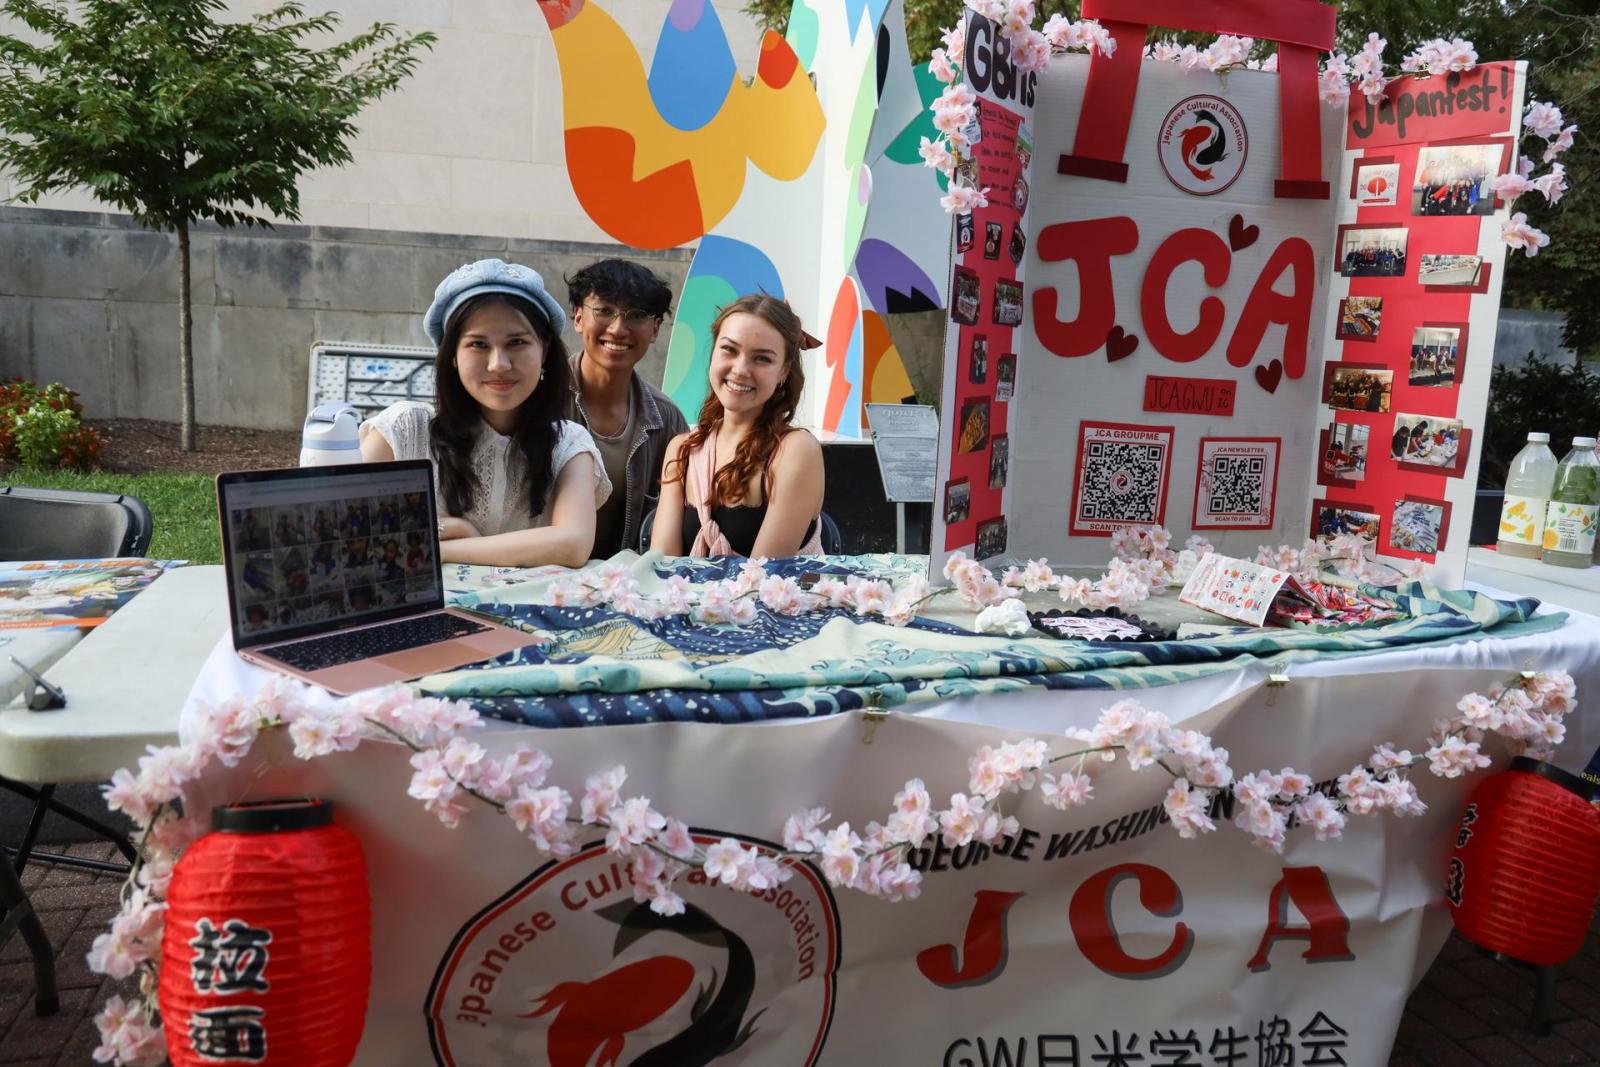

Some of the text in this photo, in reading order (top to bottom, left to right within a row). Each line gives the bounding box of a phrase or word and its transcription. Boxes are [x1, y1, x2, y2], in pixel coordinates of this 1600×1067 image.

[1163, 101, 1243, 152] Japanese Cultural Association
[1352, 66, 1509, 139] Japanfest!
[1033, 216, 1316, 380] JCA
[1094, 429, 1160, 441] JCA GROUPME
[1090, 523, 1111, 531] SCAN
[456, 910, 556, 1028] apanese
